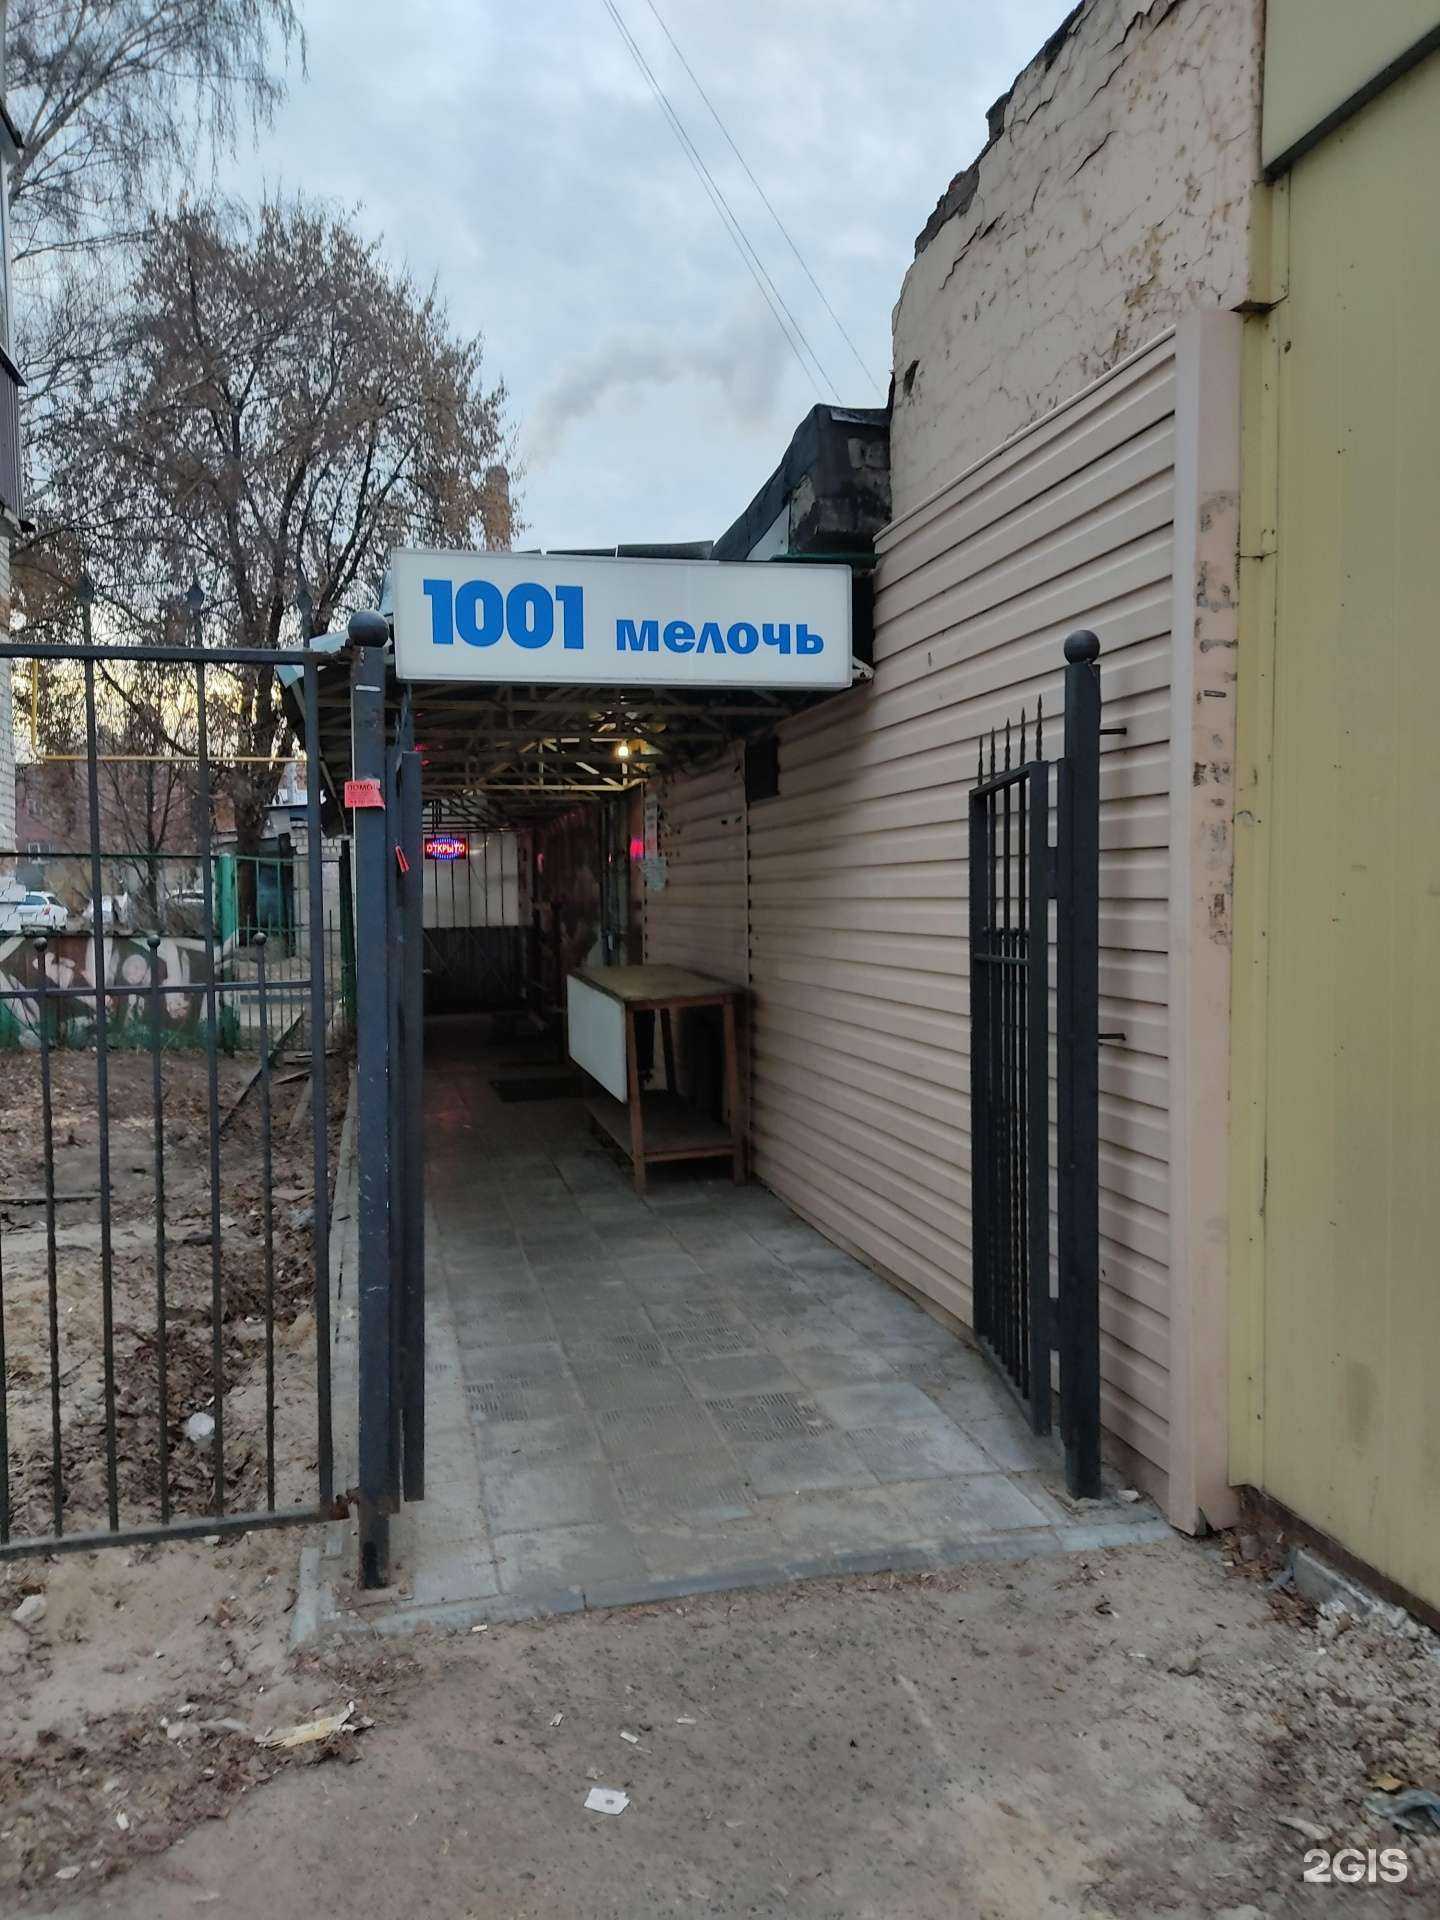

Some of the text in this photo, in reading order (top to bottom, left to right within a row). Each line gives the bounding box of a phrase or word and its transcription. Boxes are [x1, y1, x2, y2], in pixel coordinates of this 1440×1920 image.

[423, 578, 824, 655] 1001 мелочь
[426, 842, 465, 854] ОТКРЫТО
